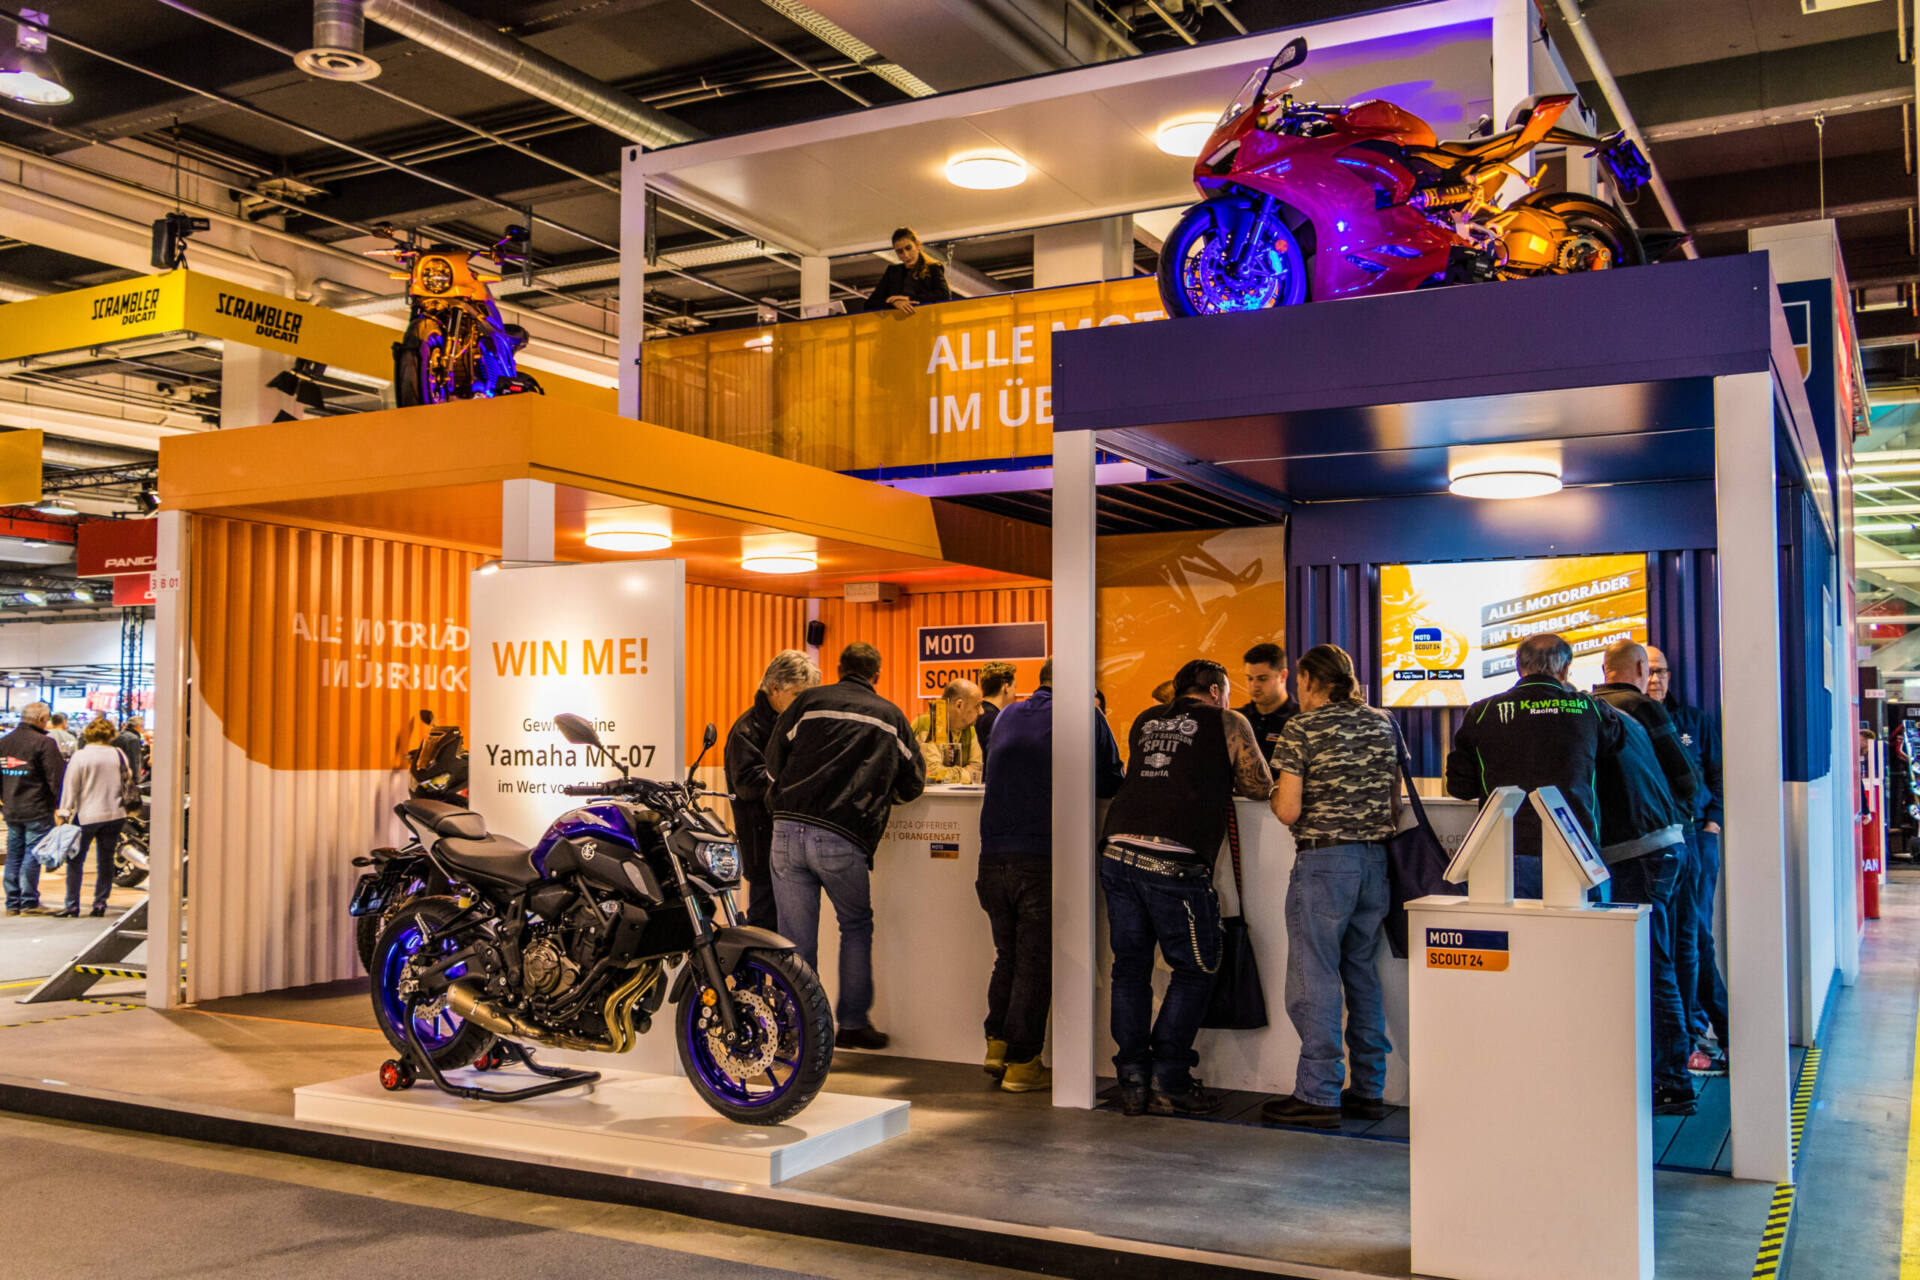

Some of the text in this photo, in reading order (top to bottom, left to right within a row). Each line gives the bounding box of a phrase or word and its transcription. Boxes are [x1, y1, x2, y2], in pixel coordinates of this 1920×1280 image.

[91, 288, 160, 320] SCRAMBLER
[215, 292, 303, 333] SCRAMBLER
[121, 310, 156, 325] DUCATI
[255, 324, 299, 344] DUCATI
[926, 325, 1034, 374] ALLE
[929, 392, 981, 435] IM
[1488, 576, 1631, 621] ALLE MOTORRÄDER
[925, 634, 975, 656] MOTO
[492, 637, 648, 677] WIN ME!
[1520, 698, 1589, 710] Kawasaki
[1530, 706, 1583, 715] Racing Team
[486, 744, 656, 768] Yamaha MT-07
[1143, 739, 1180, 753] SPLIT
[498, 779, 513, 793] im
[516, 781, 546, 794] Wert
[550, 784, 572, 794] vo
[1429, 931, 1463, 946] MOTO
[1430, 953, 1484, 968] SCOUT 24
